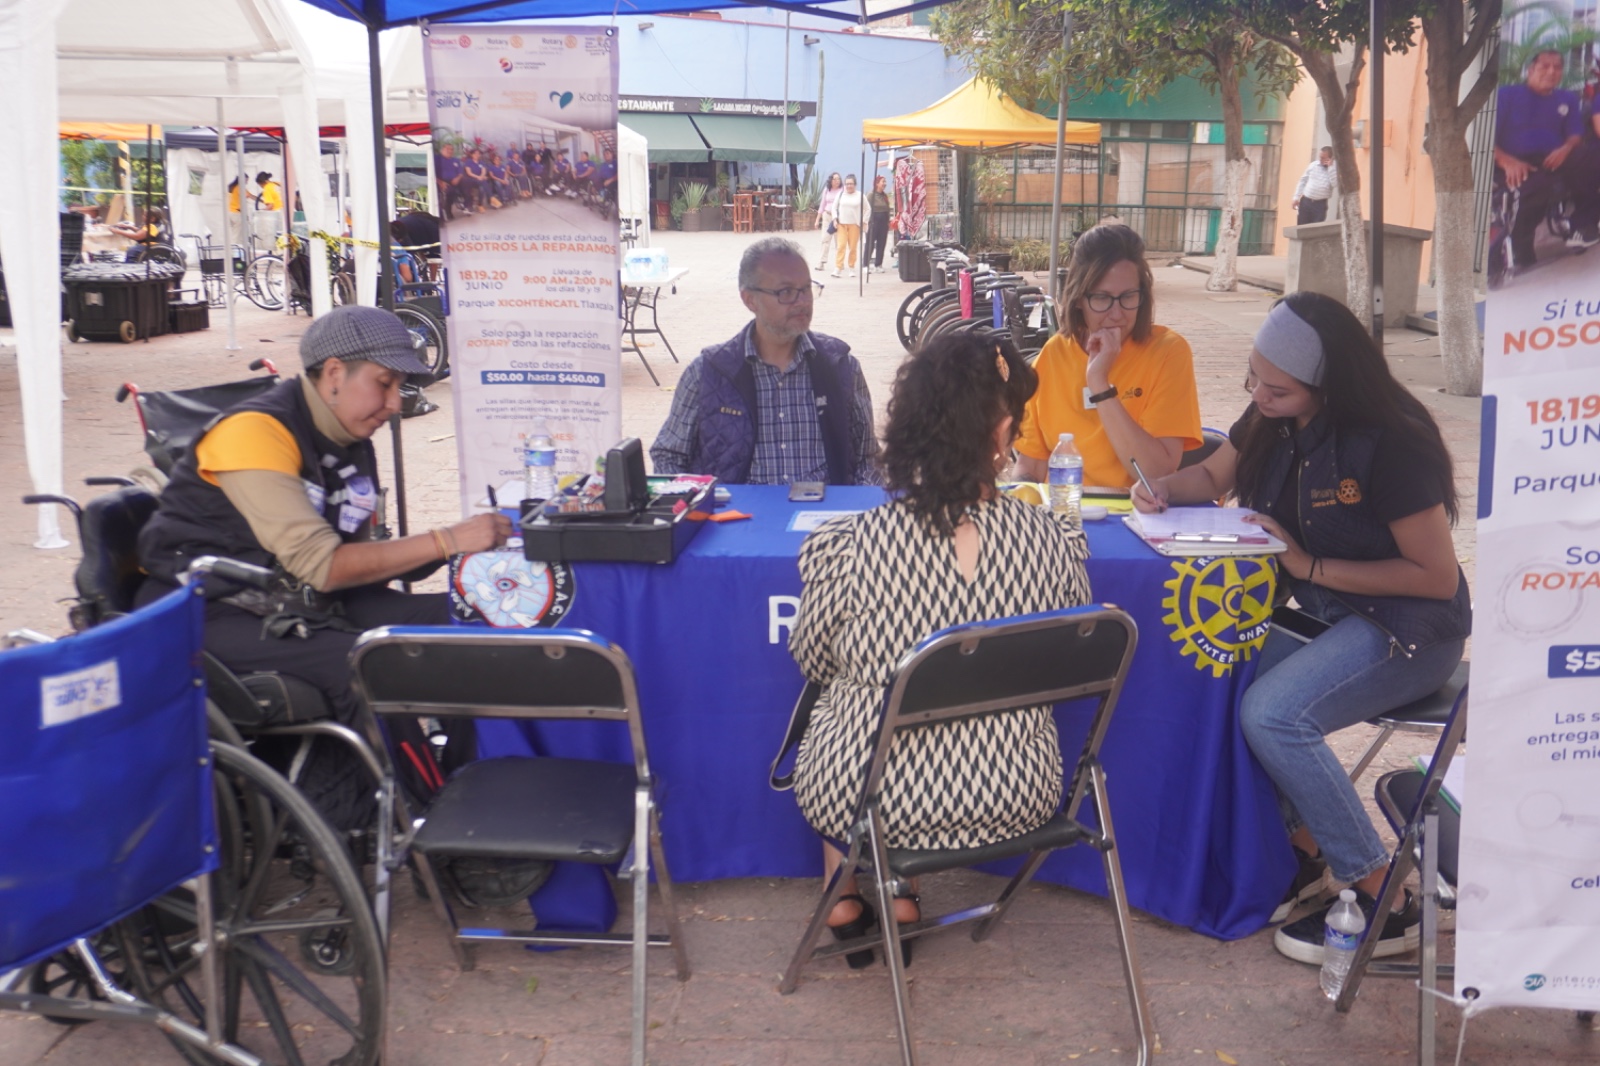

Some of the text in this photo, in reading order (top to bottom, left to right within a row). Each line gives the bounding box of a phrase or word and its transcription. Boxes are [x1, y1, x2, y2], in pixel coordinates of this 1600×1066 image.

[542, 37, 563, 46] Rotary
[617, 99, 675, 112] ESTAURANTE
[459, 232, 468, 241] Si
[470, 232, 480, 241] tu
[483, 232, 501, 241] silla
[503, 232, 515, 241] de
[518, 233, 550, 242] ruedas
[574, 232, 607, 243] dañada
[446, 241, 616, 255] NOSOTROS LA REPARAMOS
[582, 269, 592, 277] de
[465, 281, 503, 290] JUNIO
[522, 275, 546, 284] 9:00
[549, 276, 567, 285] AM
[573, 276, 596, 285] 2:00
[599, 277, 613, 286] PM
[545, 285, 556, 293] los
[457, 299, 495, 308] Parque
[580, 300, 614, 311] Tlaxcala
[1543, 298, 1567, 321] Si
[481, 328, 503, 337] Solo
[505, 330, 530, 339] paga
[533, 329, 542, 337] la
[1503, 320, 1600, 355] NOSO
[466, 338, 611, 351] ROTARY dona las refacciones
[509, 359, 573, 369] Costo desde
[486, 372, 600, 384] $50.00 hasta $450.00
[485, 398, 497, 406] Las
[1555, 711, 1587, 725] Las
[1527, 729, 1600, 747] entrega
[1551, 747, 1567, 761] el
[1571, 875, 1600, 889] Cel
